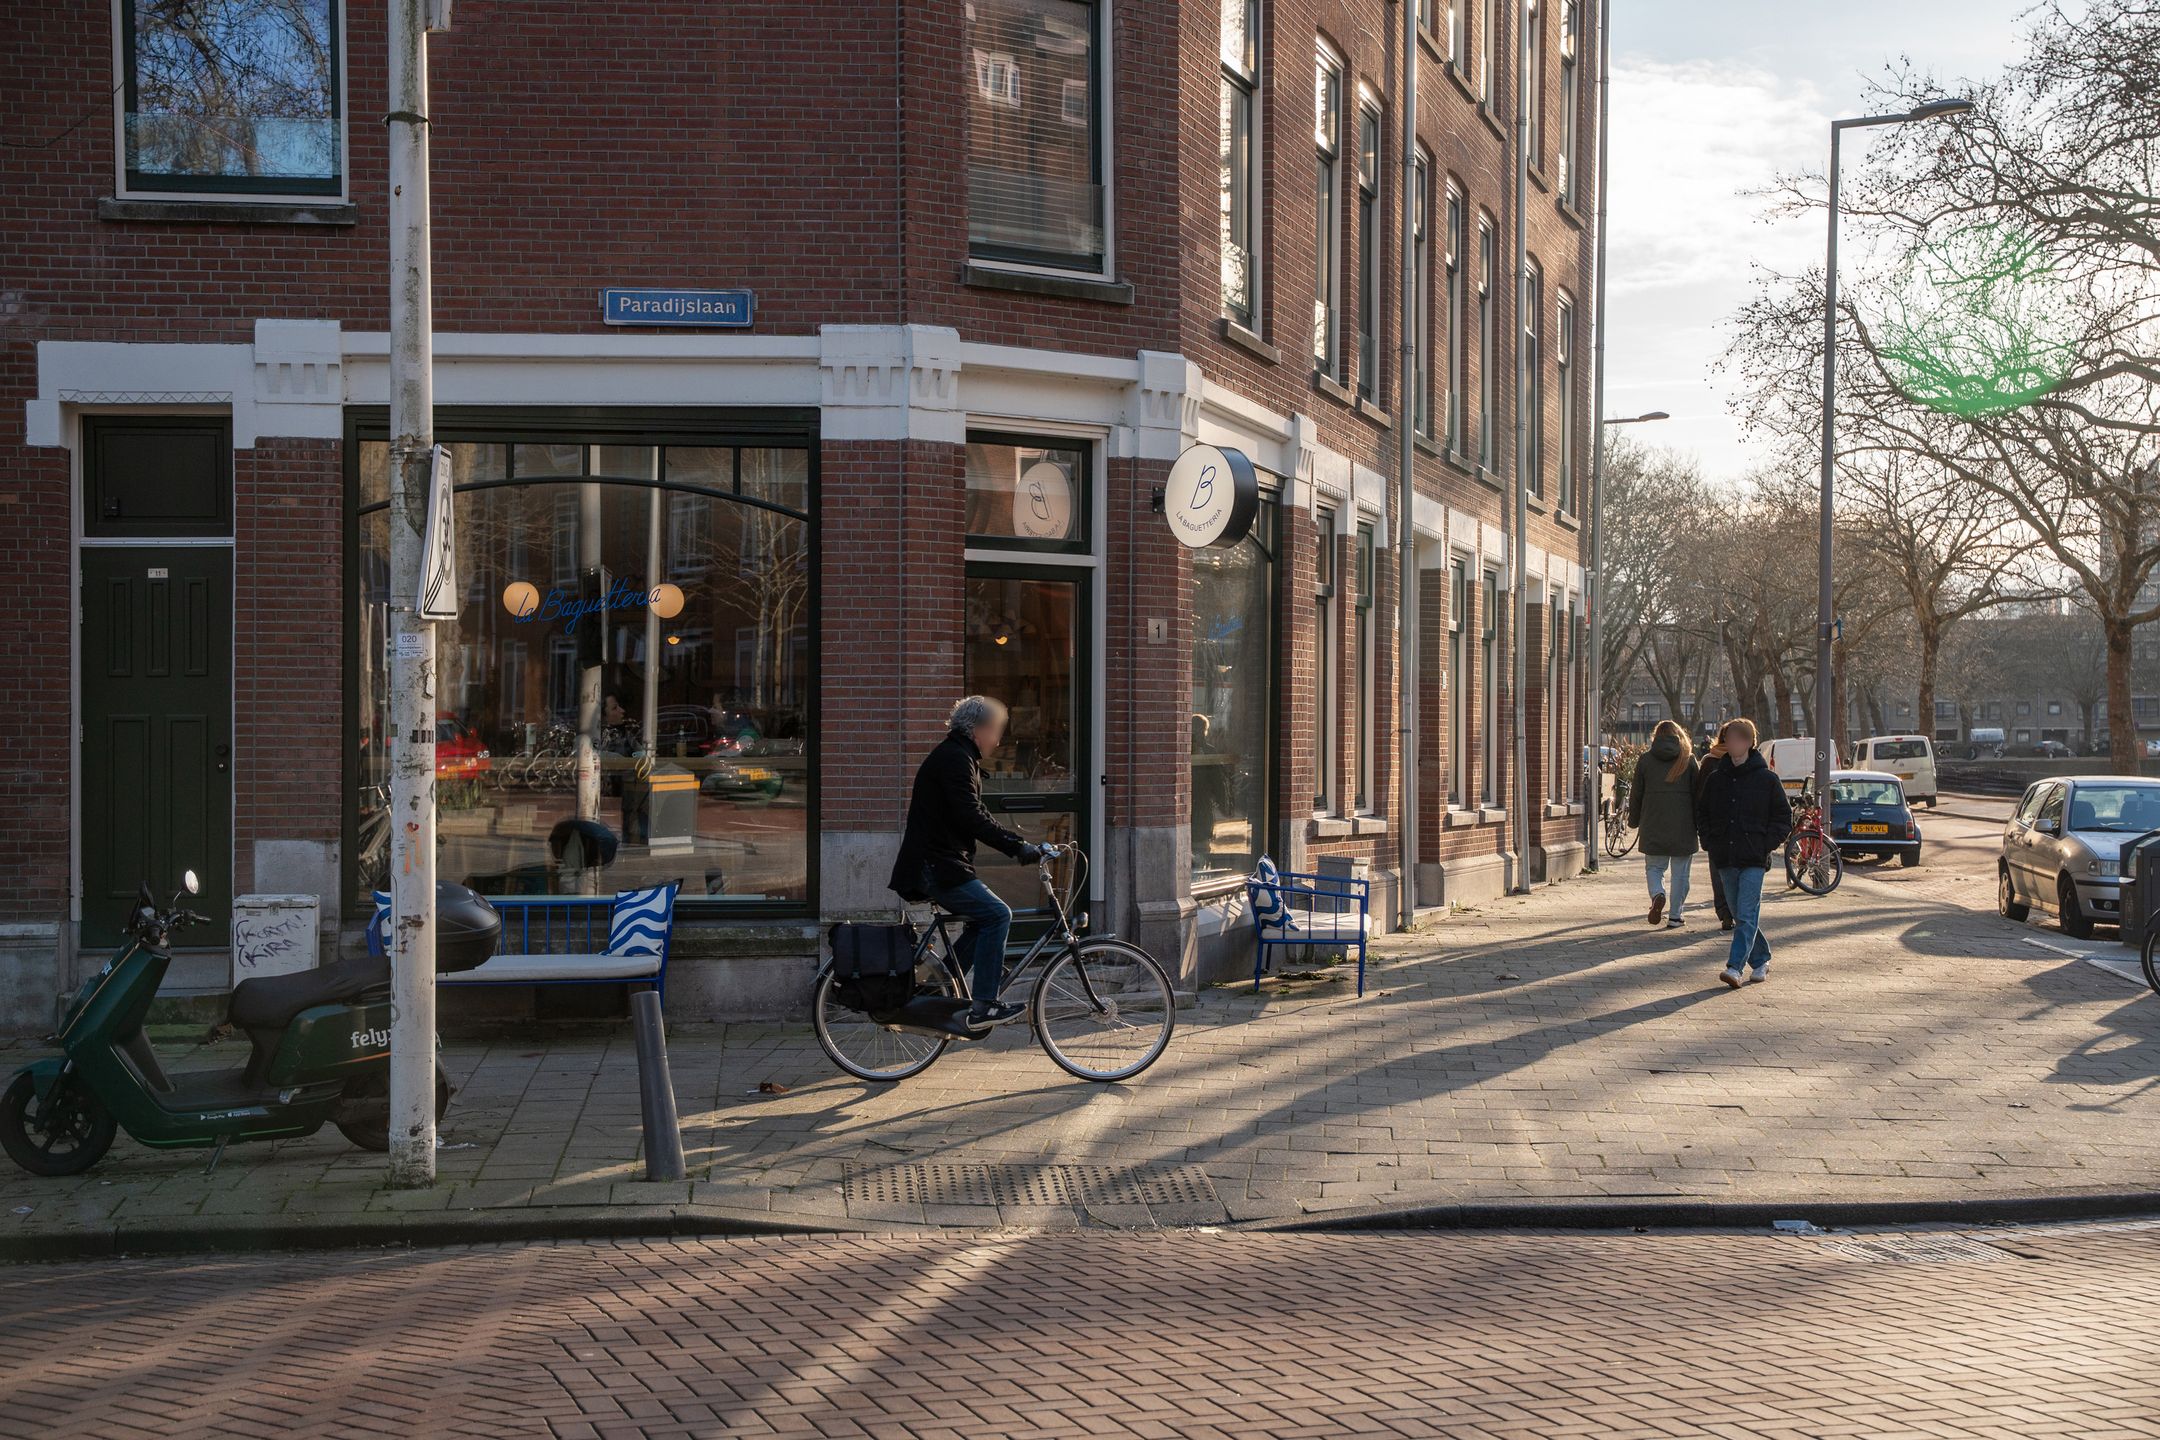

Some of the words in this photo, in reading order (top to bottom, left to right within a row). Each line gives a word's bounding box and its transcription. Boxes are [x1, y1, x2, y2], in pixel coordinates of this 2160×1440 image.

[620, 297, 736, 316] Paradijslaan
[1190, 465, 1216, 509] B
[1175, 511, 1183, 522] LA
[1182, 509, 1222, 531] BAGUETTERIA
[538, 575, 661, 635] Baguetteria
[402, 635, 417, 643] 020
[1155, 624, 1160, 639] 1
[350, 1028, 391, 1048] fely
